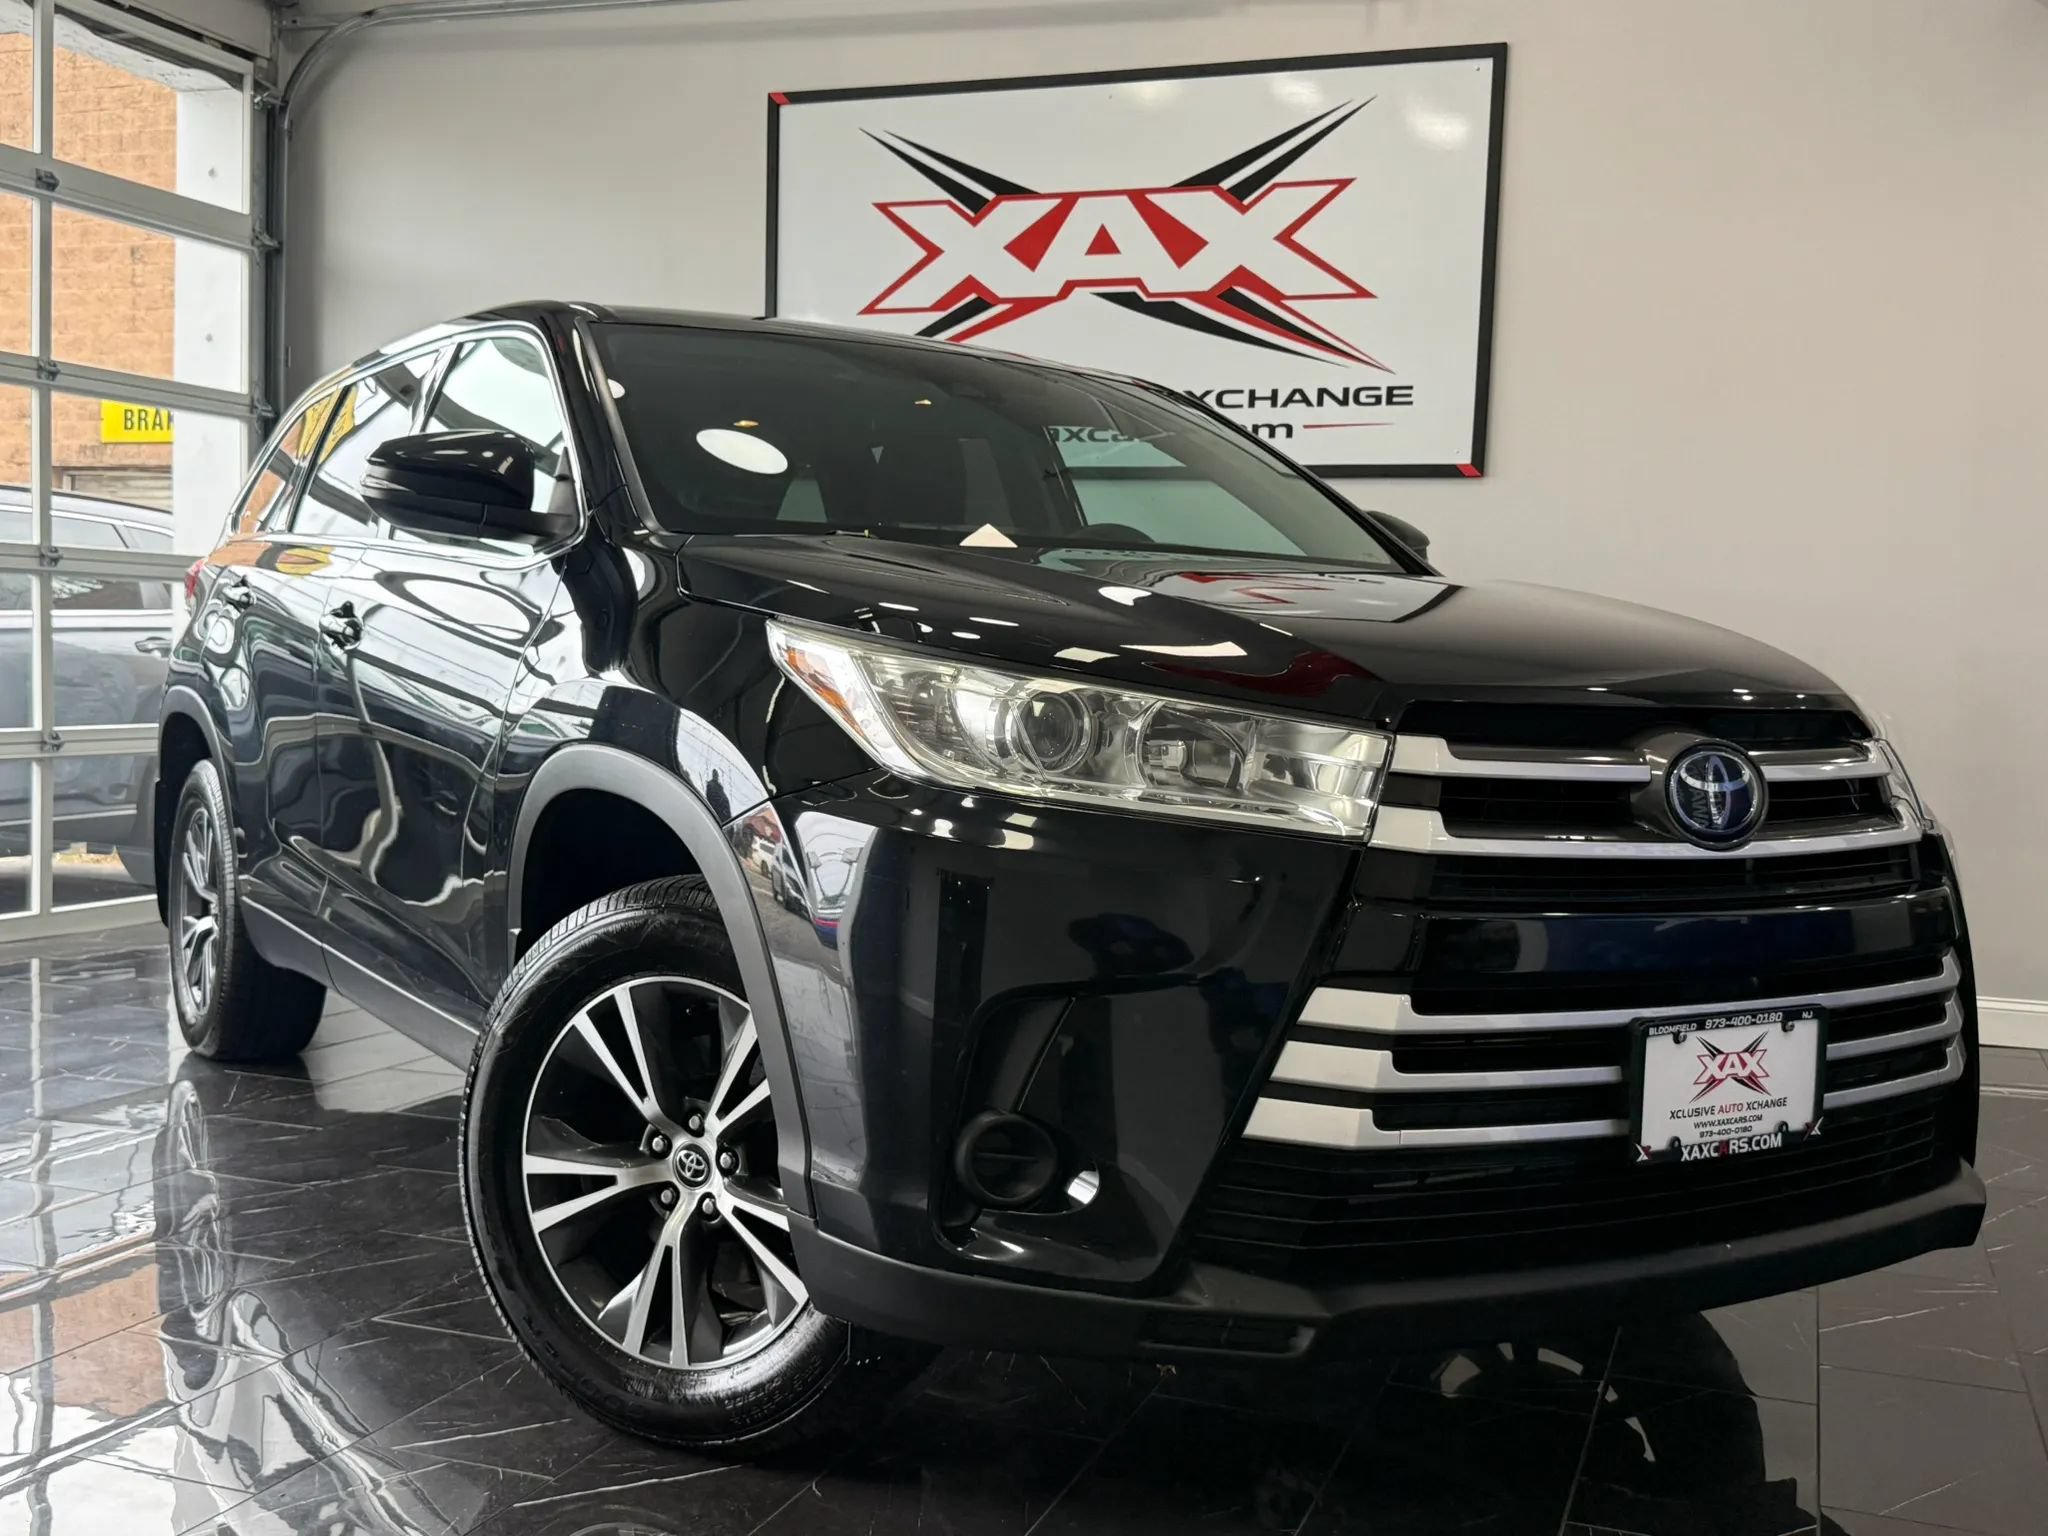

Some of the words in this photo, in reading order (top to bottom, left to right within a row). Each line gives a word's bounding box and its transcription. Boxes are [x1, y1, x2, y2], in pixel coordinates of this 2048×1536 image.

[857, 178, 1378, 315] XAX
[1183, 385, 1414, 409] XCHANGE
[1648, 1022, 1698, 1036] BLOOMFIELD
[1801, 1010, 1814, 1019] NJ
[1693, 1049, 1770, 1085] XAX
[1669, 1105, 1716, 1120] XCLUSIVE
[1717, 1103, 1744, 1115] AUTO
[1745, 1097, 1788, 1112] XCHANGE
[1693, 1114, 1763, 1129] WWW.XAXCARS.COM
[1699, 1125, 1753, 1139] 973-400-0180
[1680, 1132, 1783, 1162] XAXCARS.COM
